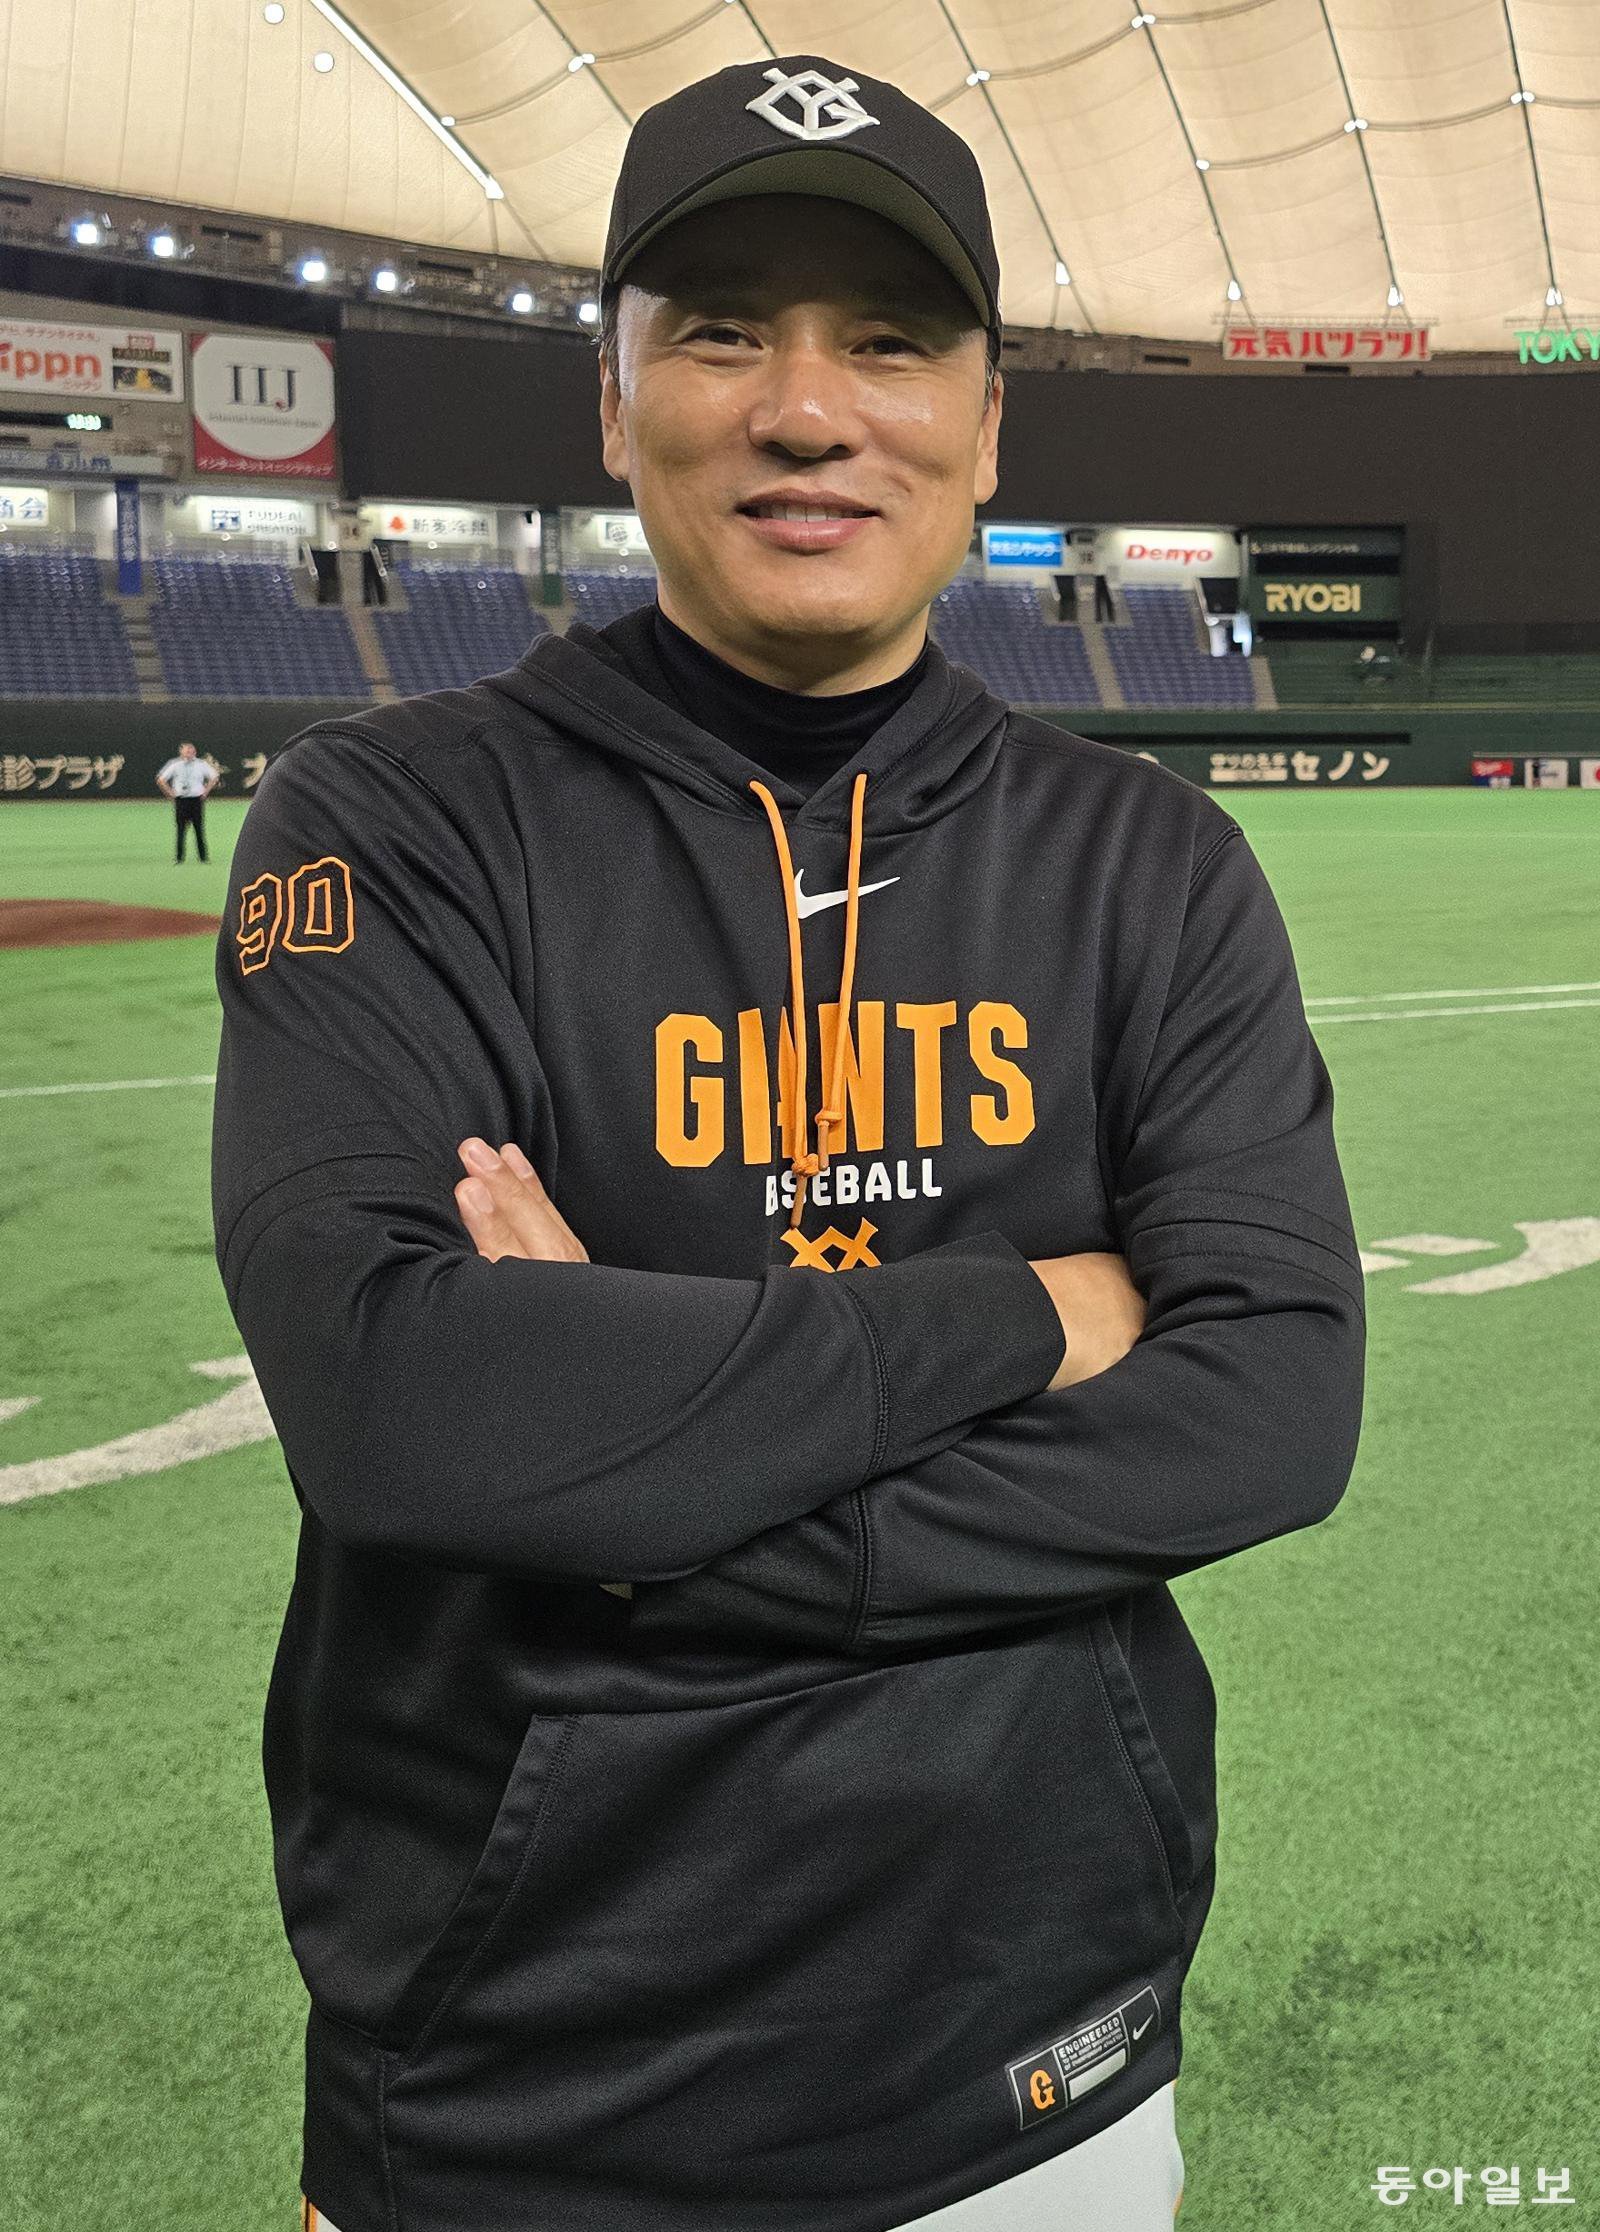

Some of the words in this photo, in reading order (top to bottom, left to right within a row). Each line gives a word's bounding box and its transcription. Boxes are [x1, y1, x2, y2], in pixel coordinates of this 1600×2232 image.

[1228, 328, 1429, 358] 元気ハツラツ!
[229, 363, 297, 413] IIJ
[1126, 544, 1214, 566] Denyo
[1264, 583, 1361, 613] RYOBI
[0, 754, 125, 791] 診プラザ
[236, 856, 355, 976] 90
[1058, 2016, 1120, 2059] ENGINEERED
